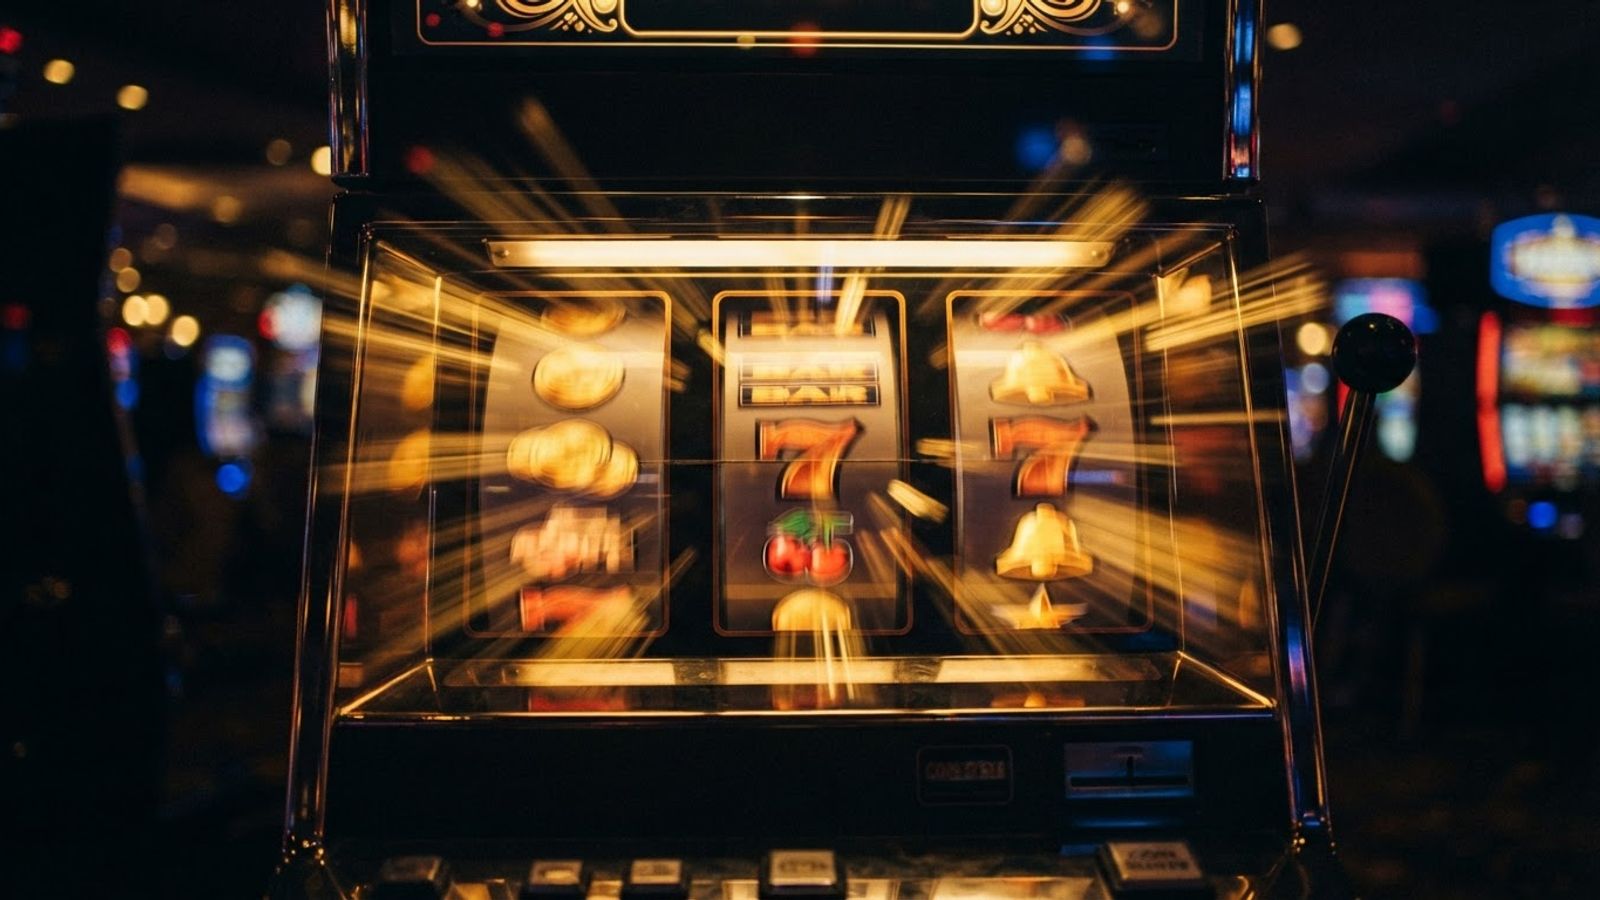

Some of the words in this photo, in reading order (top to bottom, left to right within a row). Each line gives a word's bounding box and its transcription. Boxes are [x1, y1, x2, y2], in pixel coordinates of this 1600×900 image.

[752, 385, 868, 403] BAR
[756, 416, 864, 500] 7
[989, 415, 1097, 498] 7
